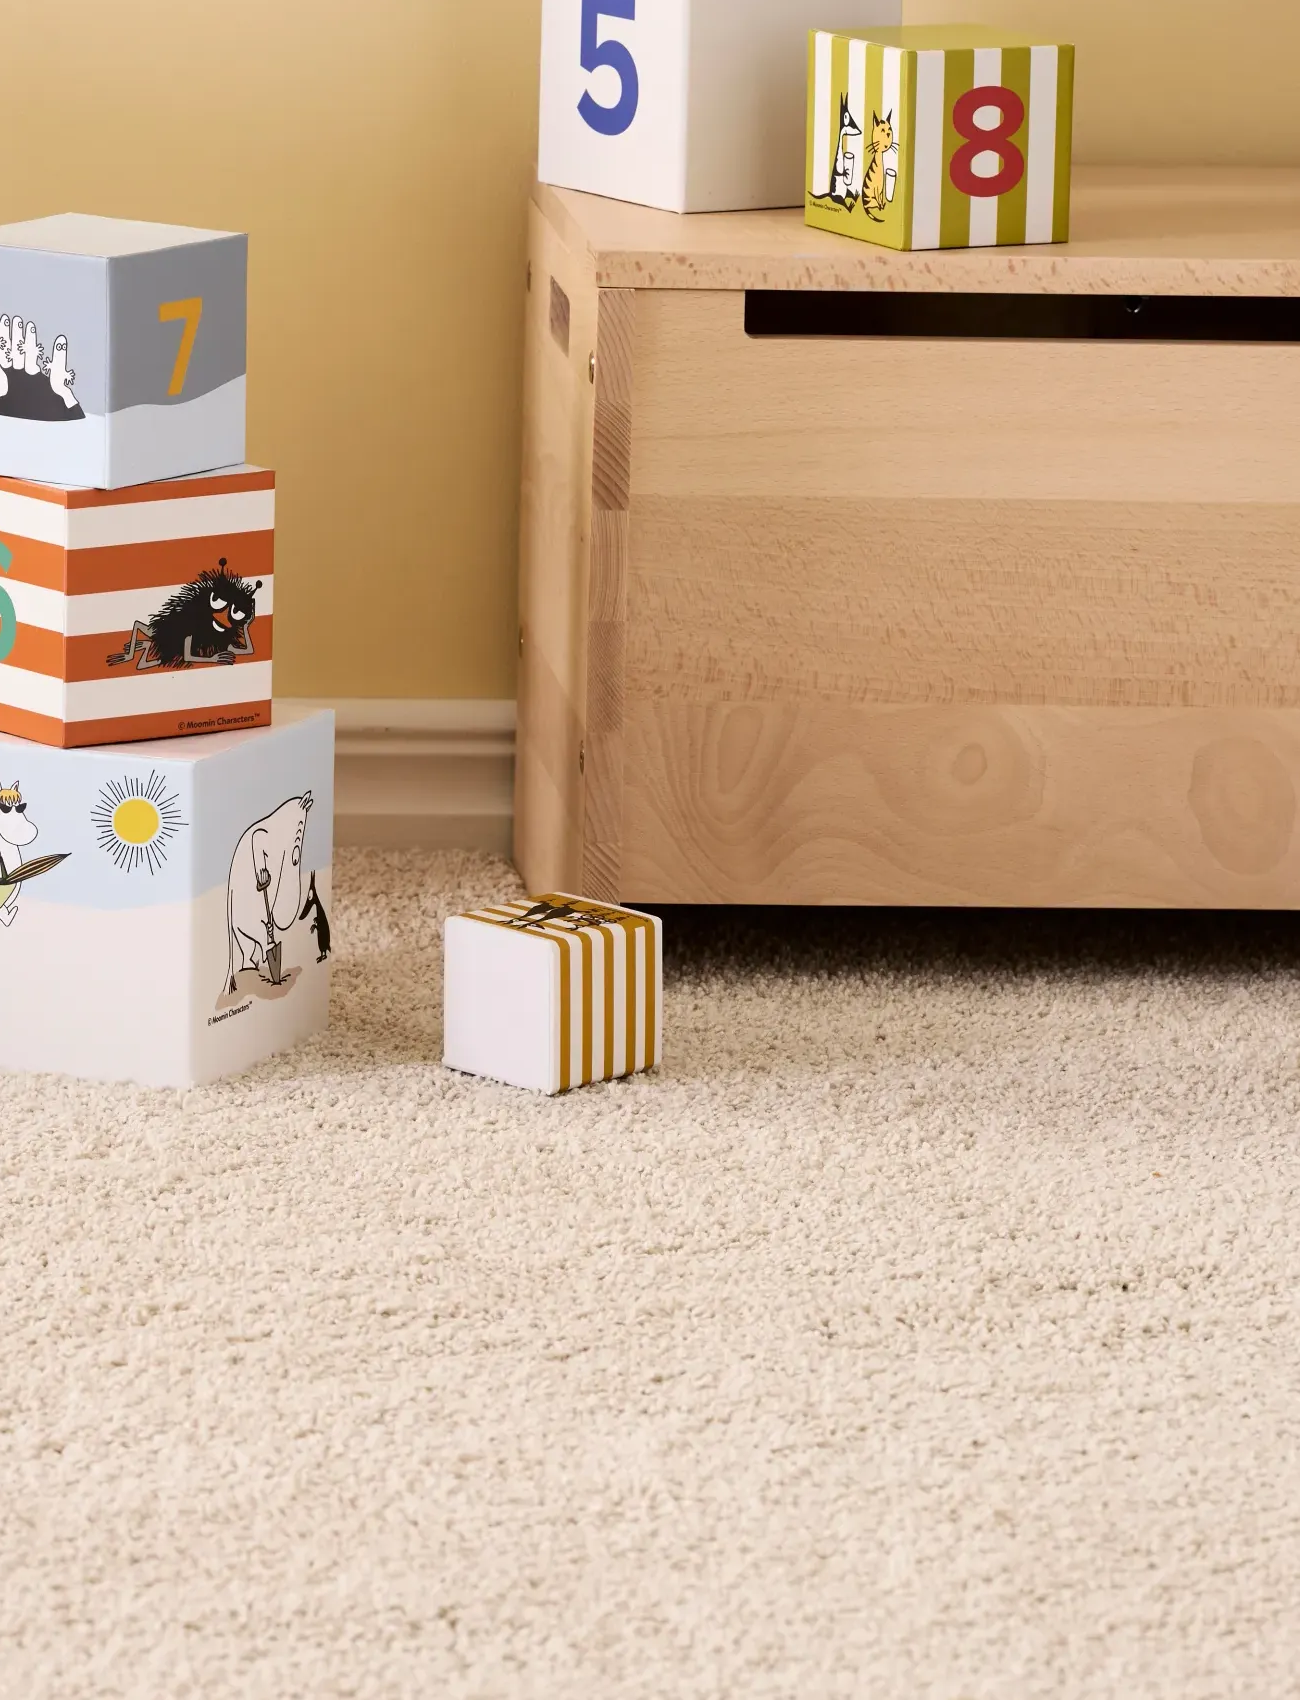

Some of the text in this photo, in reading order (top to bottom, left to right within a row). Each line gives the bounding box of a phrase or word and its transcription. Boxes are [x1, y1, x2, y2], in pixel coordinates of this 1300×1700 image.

[949, 85, 1026, 198] 8
[158, 297, 203, 396] 7
[187, 719, 215, 728] Moomin
[217, 713, 260, 725] Characters™
[213, 1012, 228, 1023] Moomin
